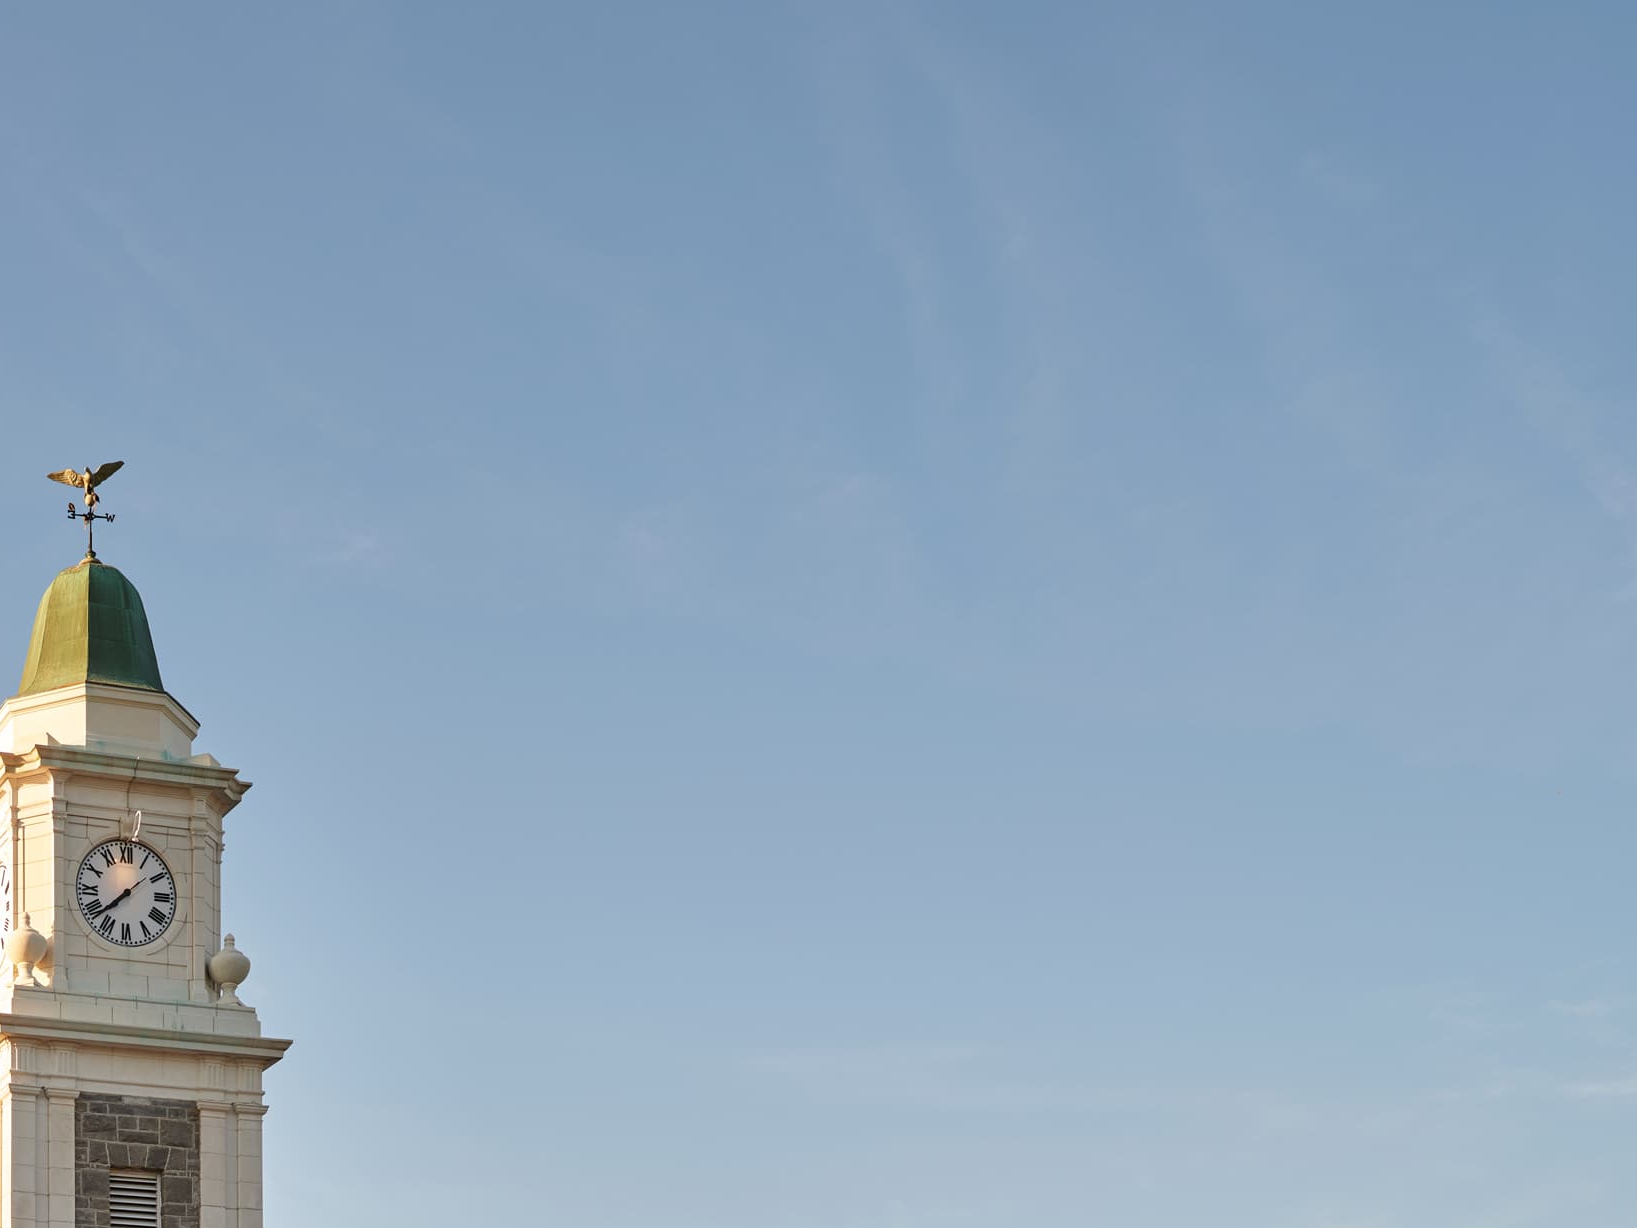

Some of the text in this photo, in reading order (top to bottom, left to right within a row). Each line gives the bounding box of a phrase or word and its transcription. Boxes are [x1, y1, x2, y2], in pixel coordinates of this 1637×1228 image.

[100, 848, 116, 868] XI
[120, 846, 133, 864] XII
[86, 864, 103, 878] X
[149, 872, 165, 884] II
[154, 892, 170, 903] III
